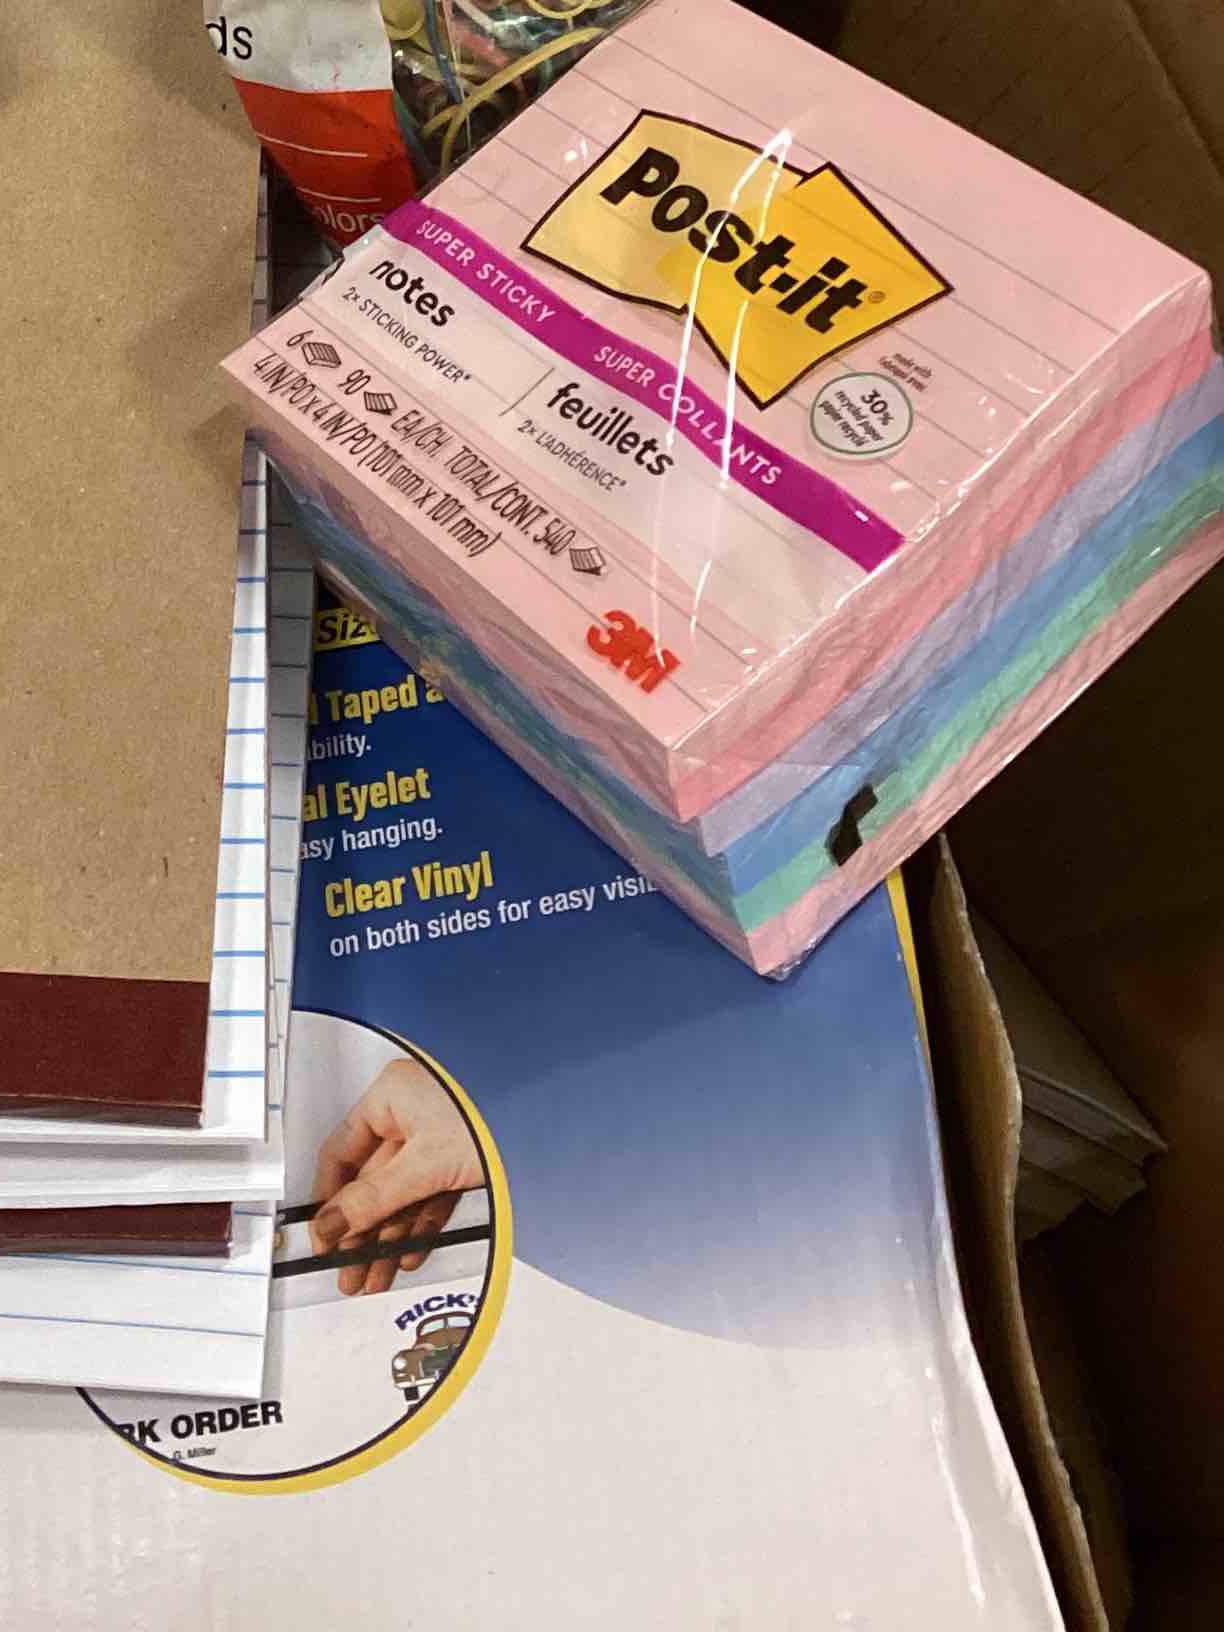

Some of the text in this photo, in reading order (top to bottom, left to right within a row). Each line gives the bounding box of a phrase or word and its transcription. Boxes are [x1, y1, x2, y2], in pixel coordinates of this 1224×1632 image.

[600, 147, 868, 334] Post-it
[356, 296, 418, 352] STICKING
[370, 259, 456, 328] notes
[286, 329, 313, 349] 6
[337, 368, 366, 397] 90
[416, 218, 783, 486] SUPER STICKY SUPER COLLANTS
[546, 382, 675, 478] feuillets
[860, 389, 894, 426] 30%
[587, 610, 681, 696] 3M
[326, 674, 419, 725] Taped
[307, 732, 372, 761] bility.
[336, 768, 432, 821] Eyelet
[342, 817, 443, 853] hanging.
[324, 851, 495, 919] Clear Vinyl
[329, 933, 360, 958] on
[366, 918, 421, 951] both
[427, 906, 492, 939] sides
[497, 895, 531, 925] for
[539, 885, 596, 915] easy
[170, 1400, 284, 1439] ORDER
[187, 1446, 217, 1460] Miller
